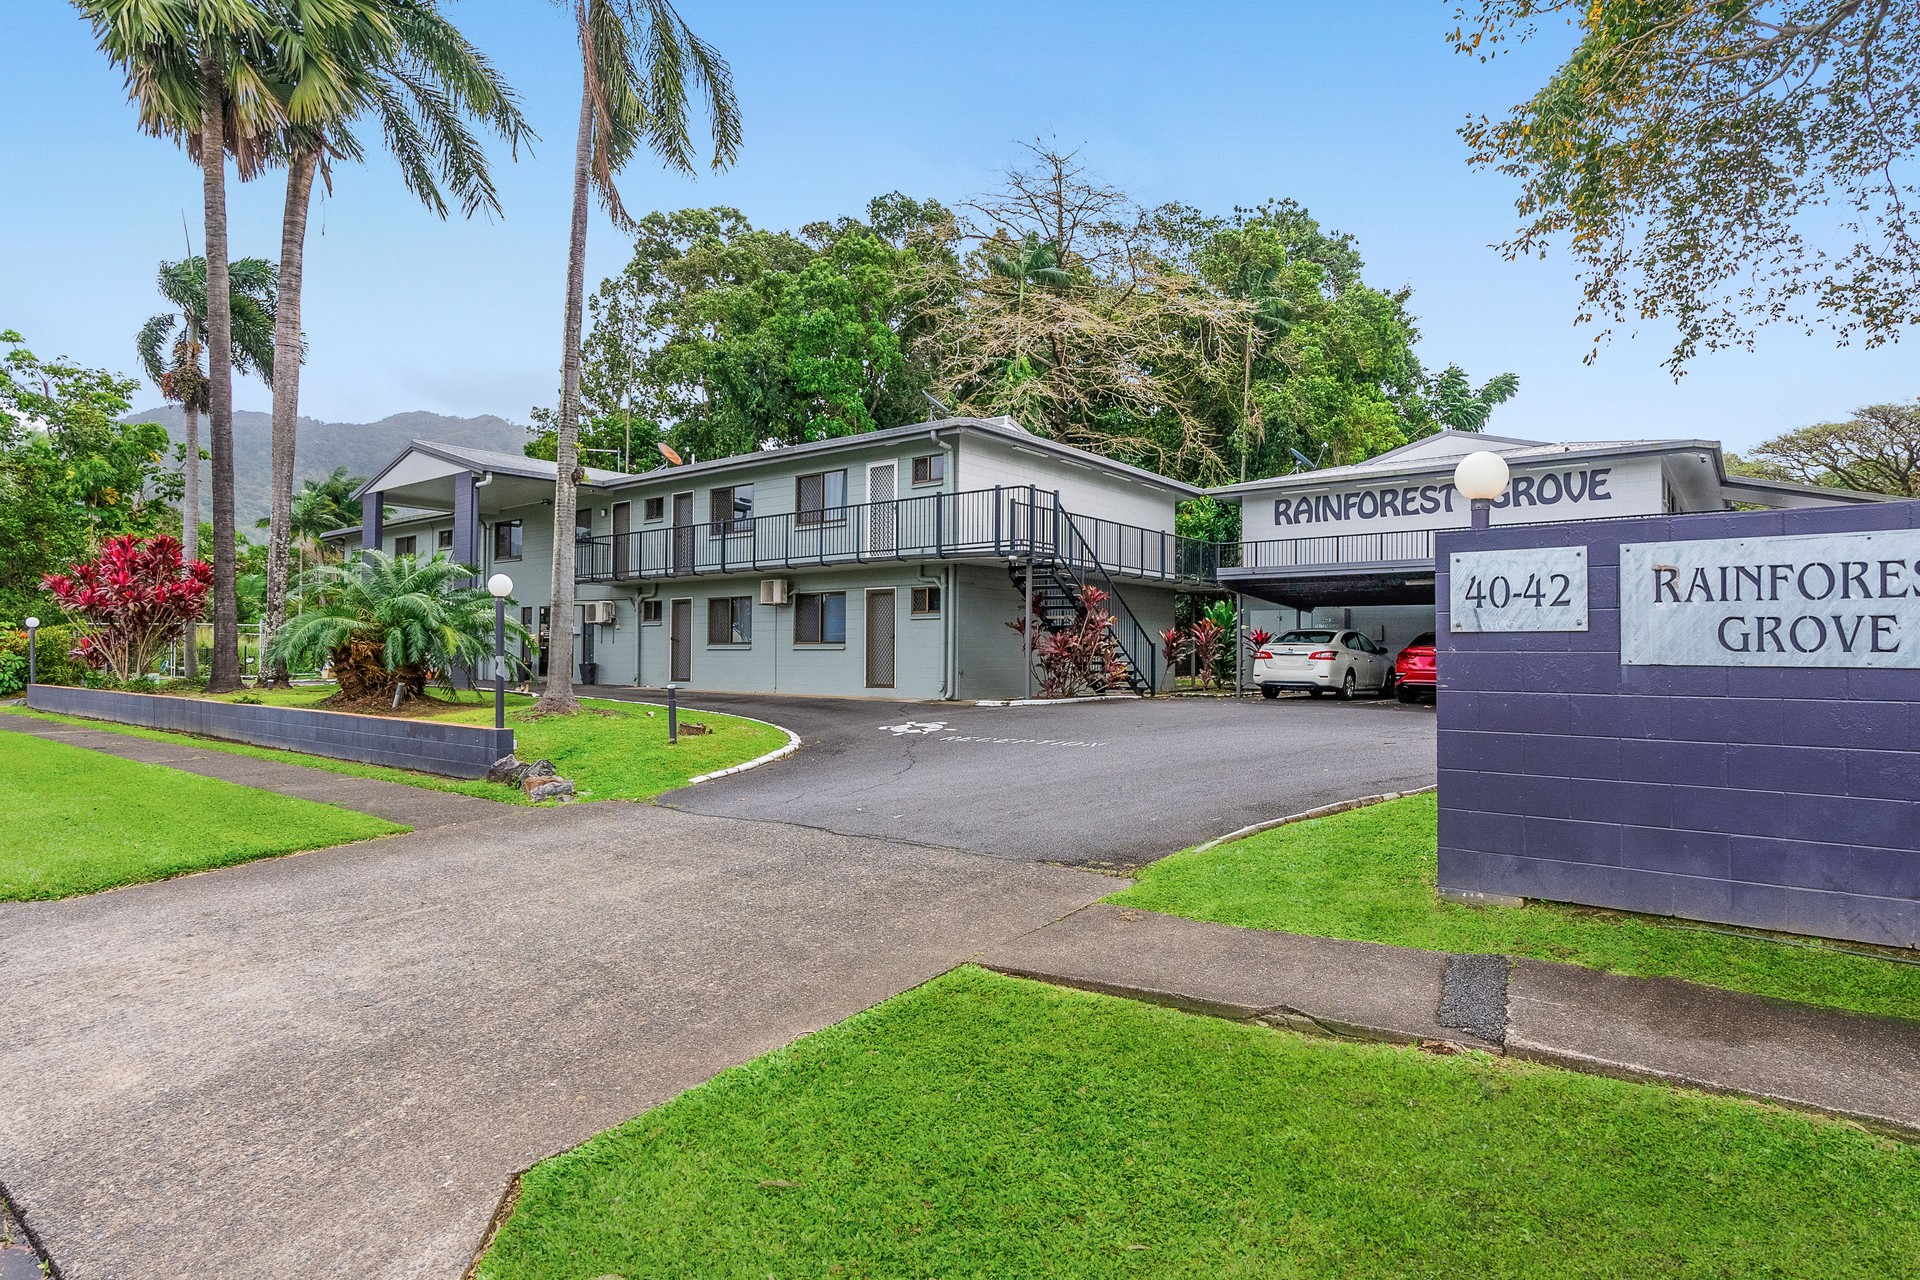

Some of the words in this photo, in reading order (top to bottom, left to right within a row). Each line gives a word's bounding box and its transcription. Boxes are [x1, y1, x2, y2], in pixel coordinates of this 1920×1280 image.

[1274, 483, 1457, 525] RAINFOREST
[1465, 573, 1572, 609] 40-42
[1652, 559, 1920, 604] RAINFORE
[1717, 615, 1901, 653] GROVE
[938, 735, 1107, 747] RECEPTION
